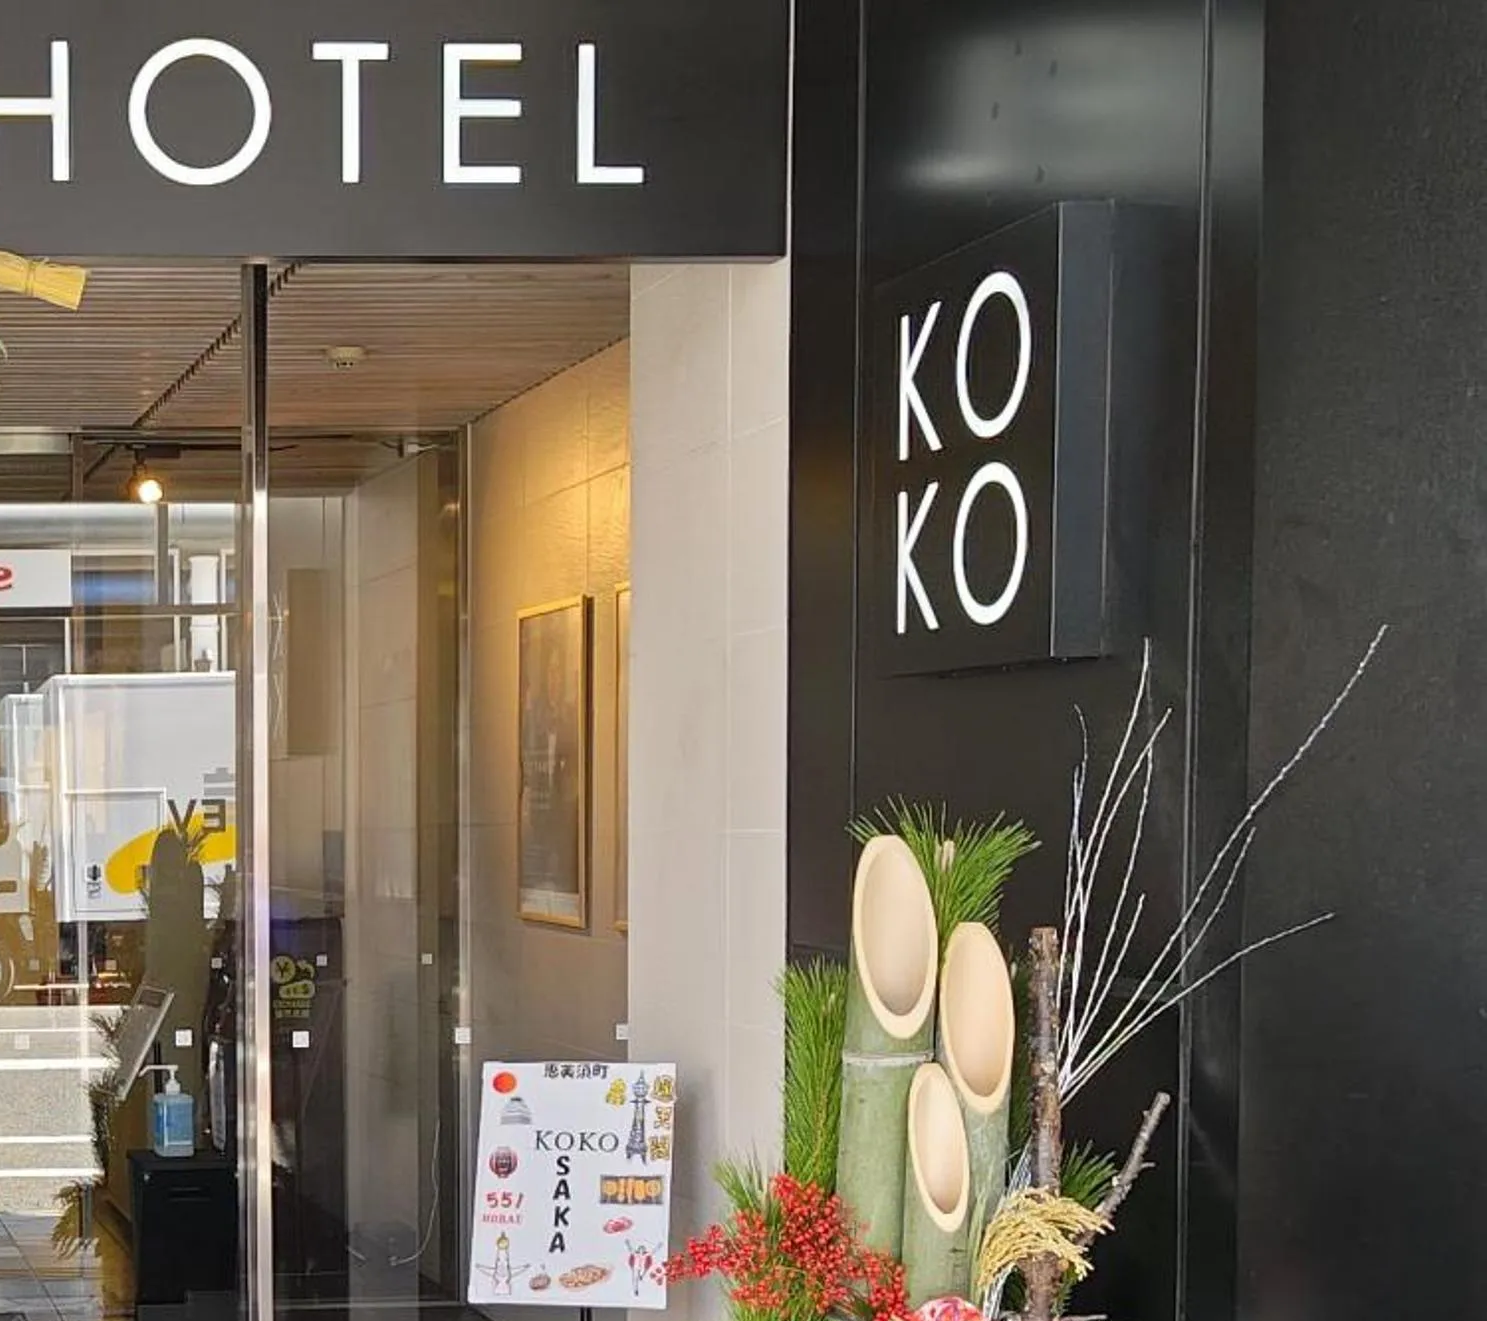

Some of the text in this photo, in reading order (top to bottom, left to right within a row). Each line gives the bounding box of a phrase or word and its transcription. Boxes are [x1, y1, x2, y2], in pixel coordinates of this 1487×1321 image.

[898, 271, 1032, 461] KO
[896, 461, 1029, 634] KO
[535, 1130, 620, 1153] KOKO
